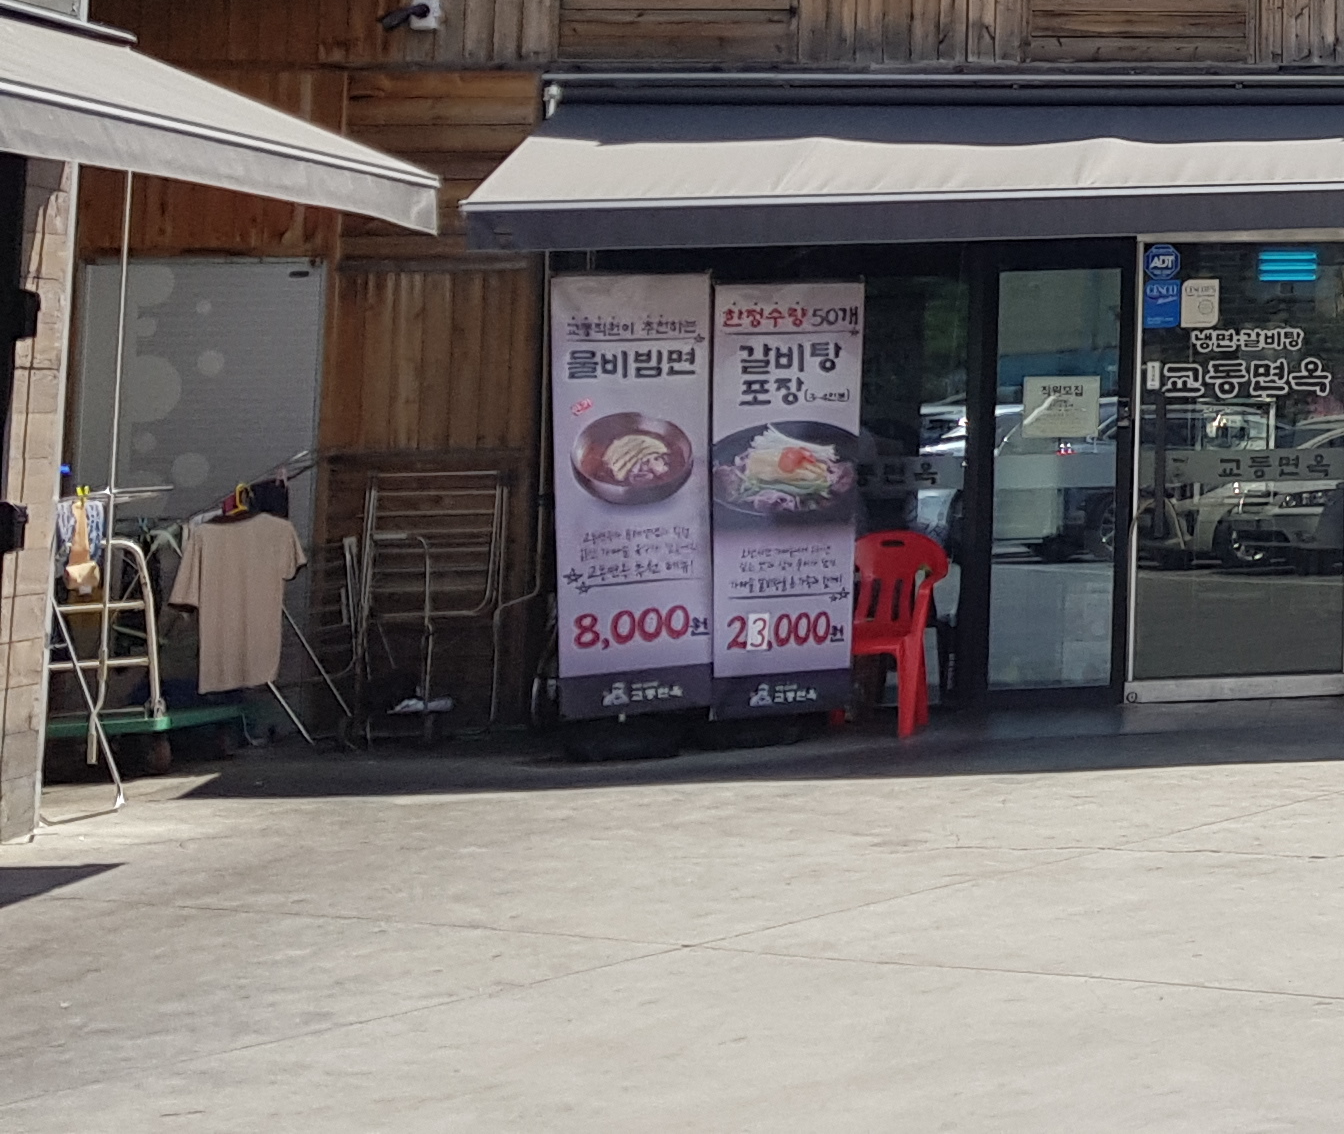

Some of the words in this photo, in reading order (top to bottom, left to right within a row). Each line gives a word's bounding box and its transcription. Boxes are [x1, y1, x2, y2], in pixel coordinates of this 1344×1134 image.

[1150, 255, 1174, 269] ADT
[721, 306, 808, 328] 한정수량
[811, 306, 858, 326] 50개
[567, 348, 696, 379] 물비빔면
[739, 342, 842, 375] 갈비탕
[738, 377, 804, 406] 포장
[1162, 358, 1332, 398] 교동면옥
[1219, 453, 1331, 479] 교동면옥
[573, 604, 711, 650] 8,000원
[726, 610, 845, 652] 23,000원
